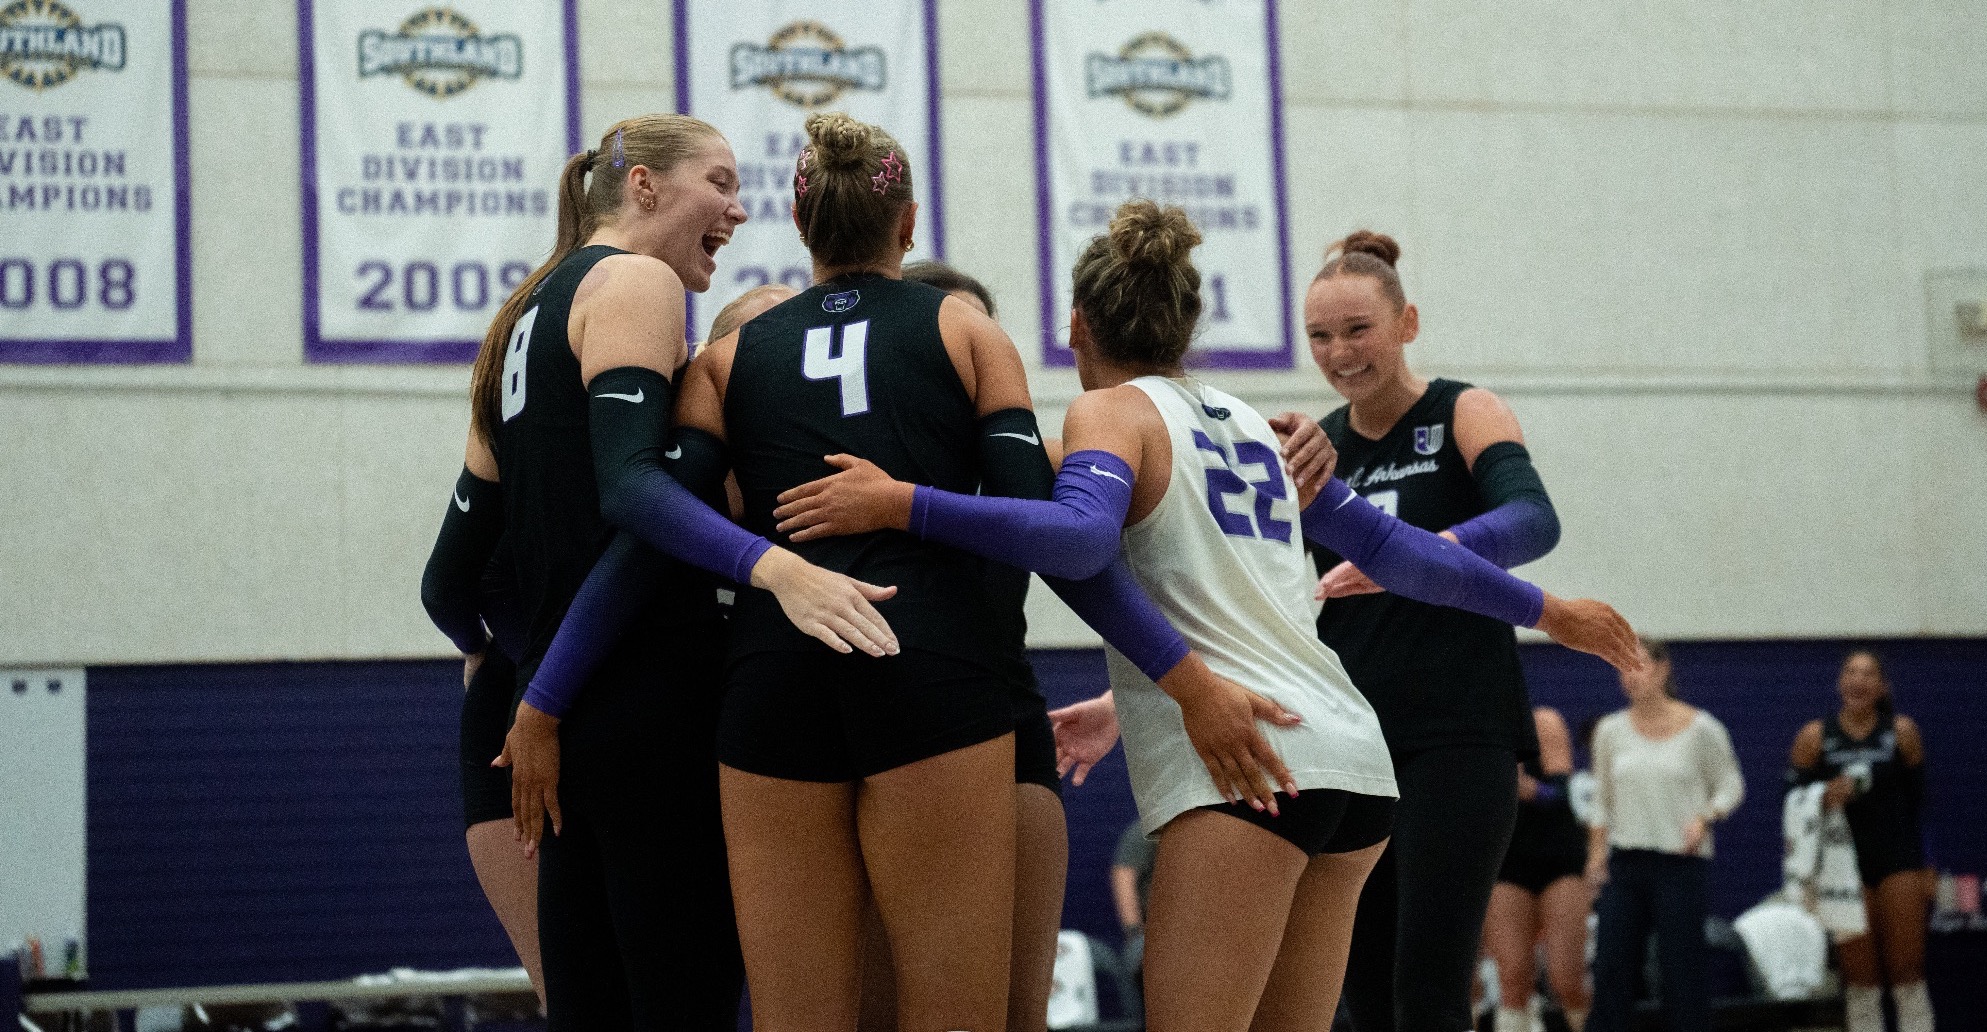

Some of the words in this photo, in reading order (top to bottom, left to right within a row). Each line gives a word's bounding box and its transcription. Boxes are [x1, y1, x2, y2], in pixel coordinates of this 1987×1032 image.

[396, 121, 488, 149] EAST
[1119, 141, 1199, 166] EAST
[361, 154, 524, 182] DIVISION
[0, 184, 152, 212] MPIONS
[337, 186, 548, 217] CHAMPIONS
[800, 318, 871, 418] 4
[1189, 427, 1293, 546] 22
